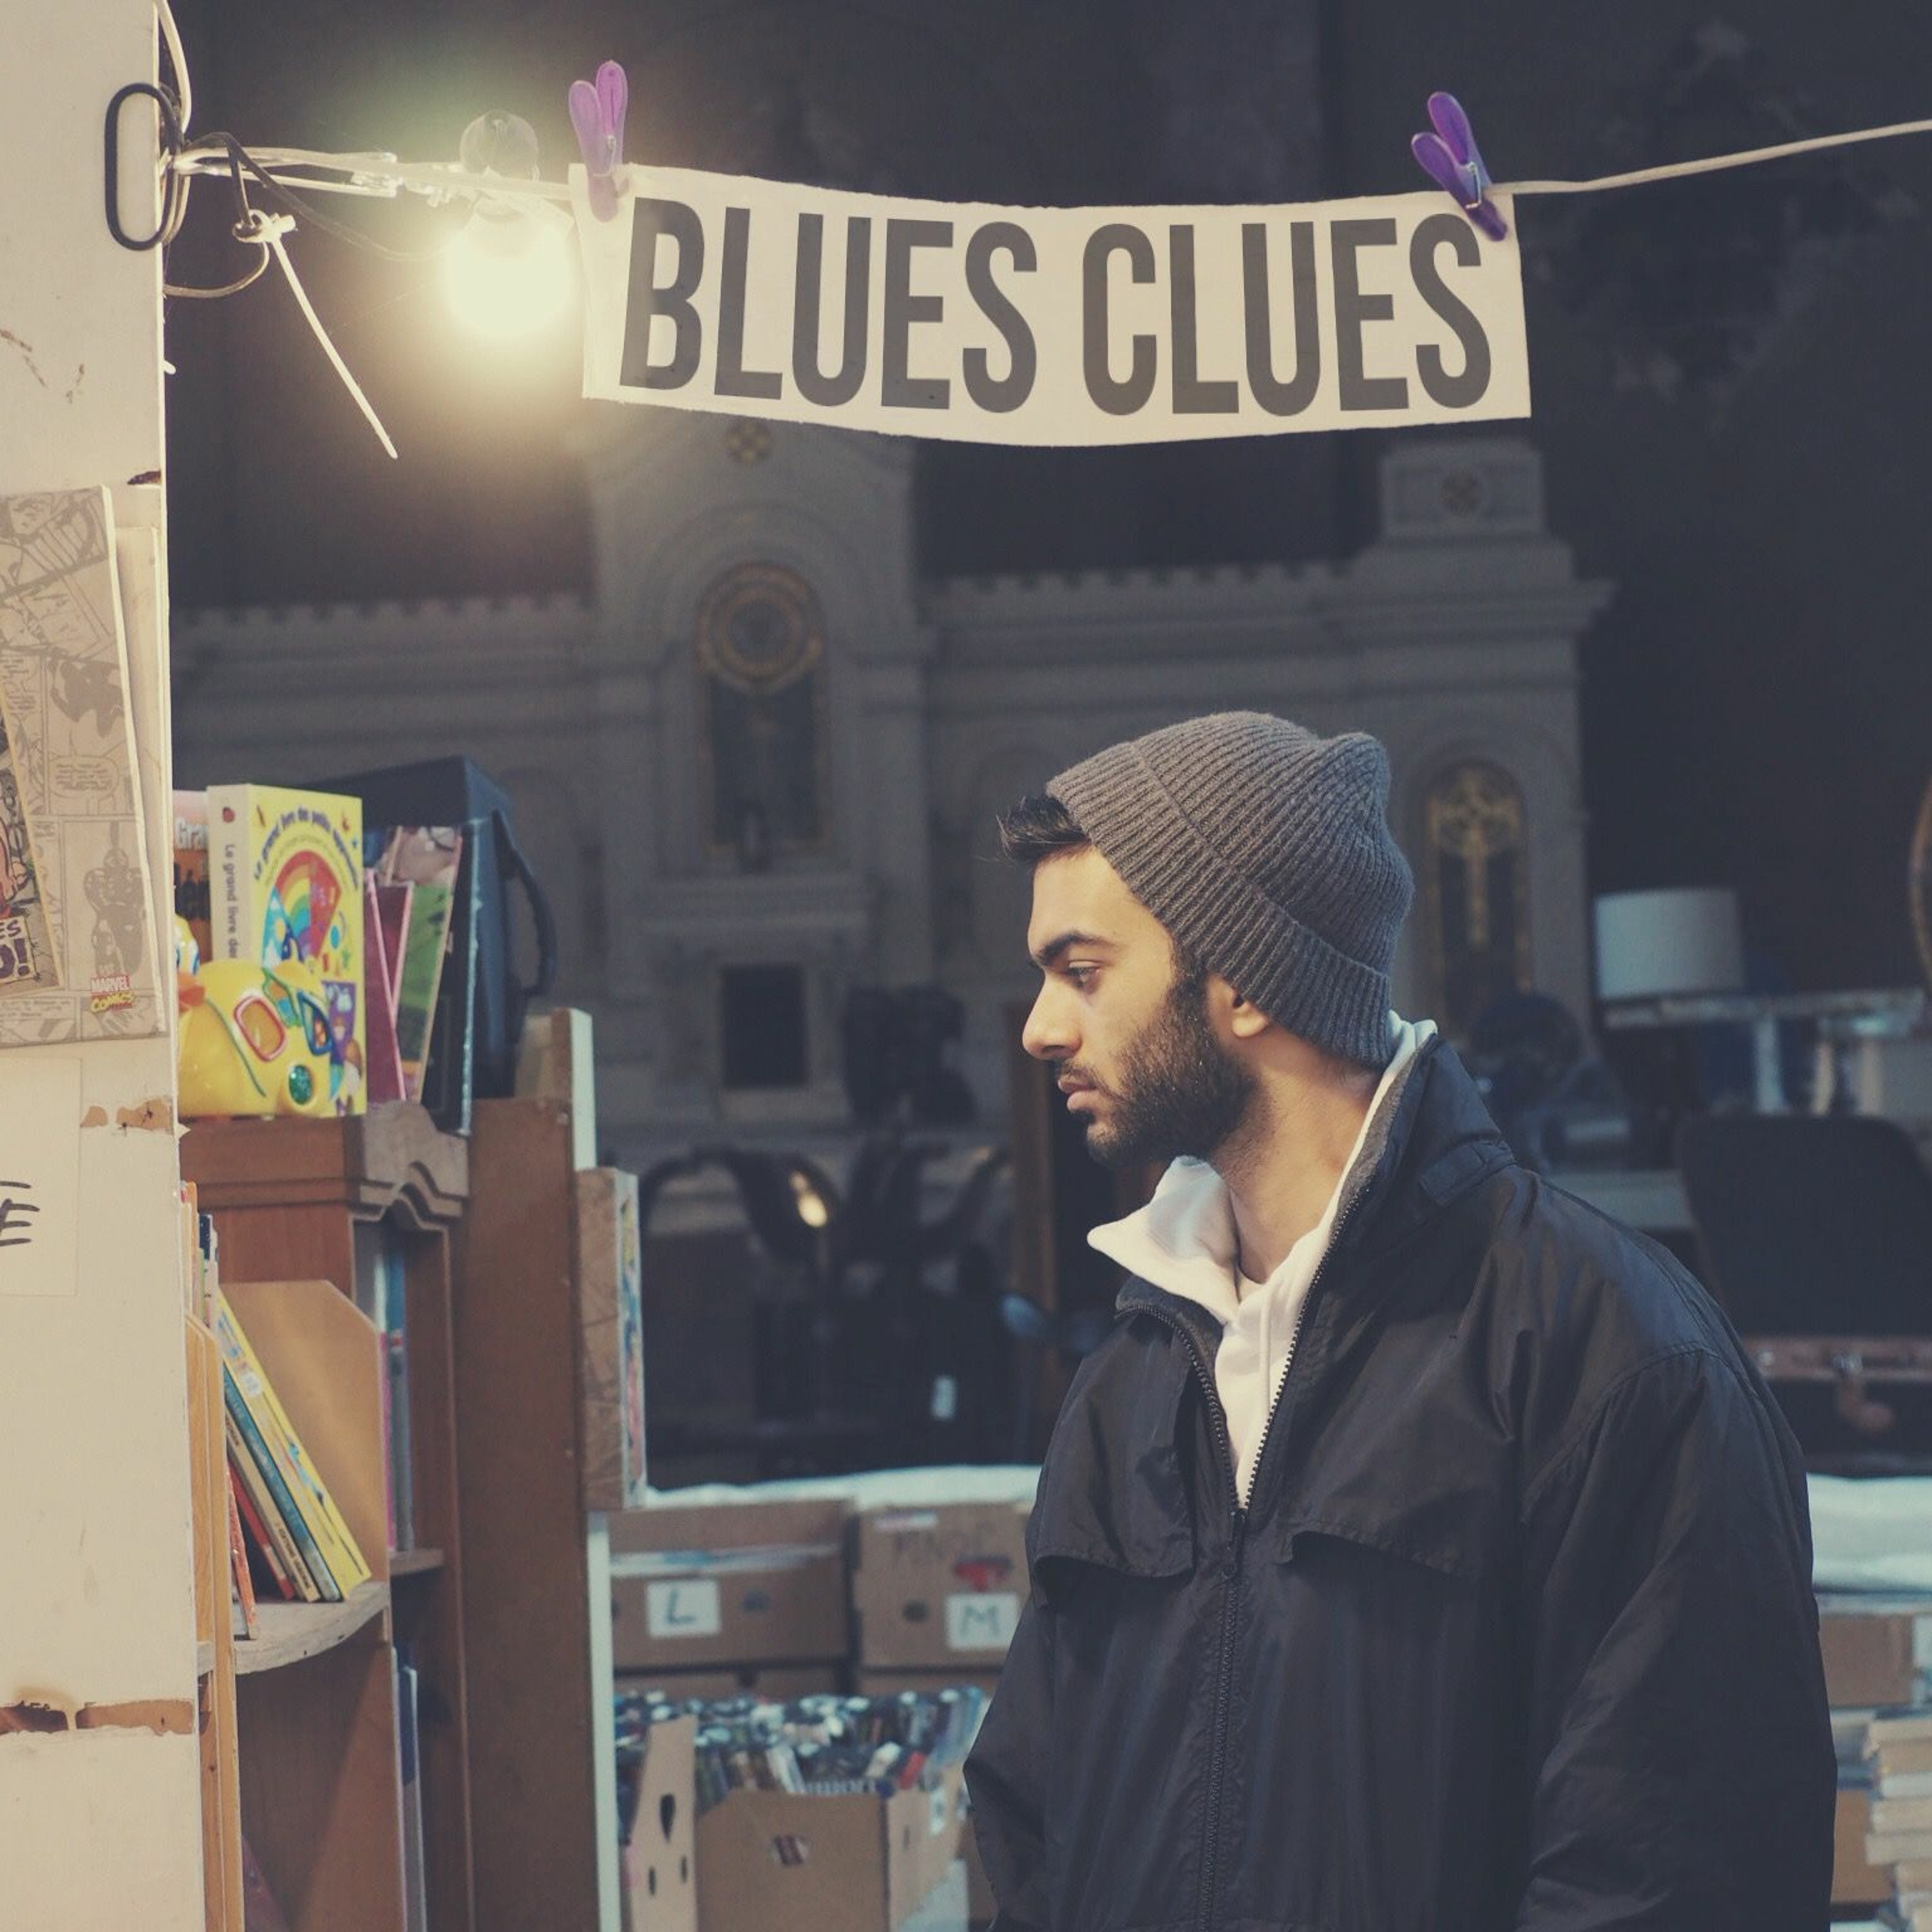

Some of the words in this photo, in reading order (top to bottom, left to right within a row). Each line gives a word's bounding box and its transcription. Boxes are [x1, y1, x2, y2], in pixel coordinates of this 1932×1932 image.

[620, 197, 1037, 413] BLUES
[1083, 213, 1491, 417] CLUES
[225, 844, 236, 858] Le
[223, 864, 239, 902] grand
[228, 906, 239, 933] livre
[91, 976, 129, 992] MARVEL
[665, 1589, 697, 1625] L
[960, 1604, 1000, 1636] M
